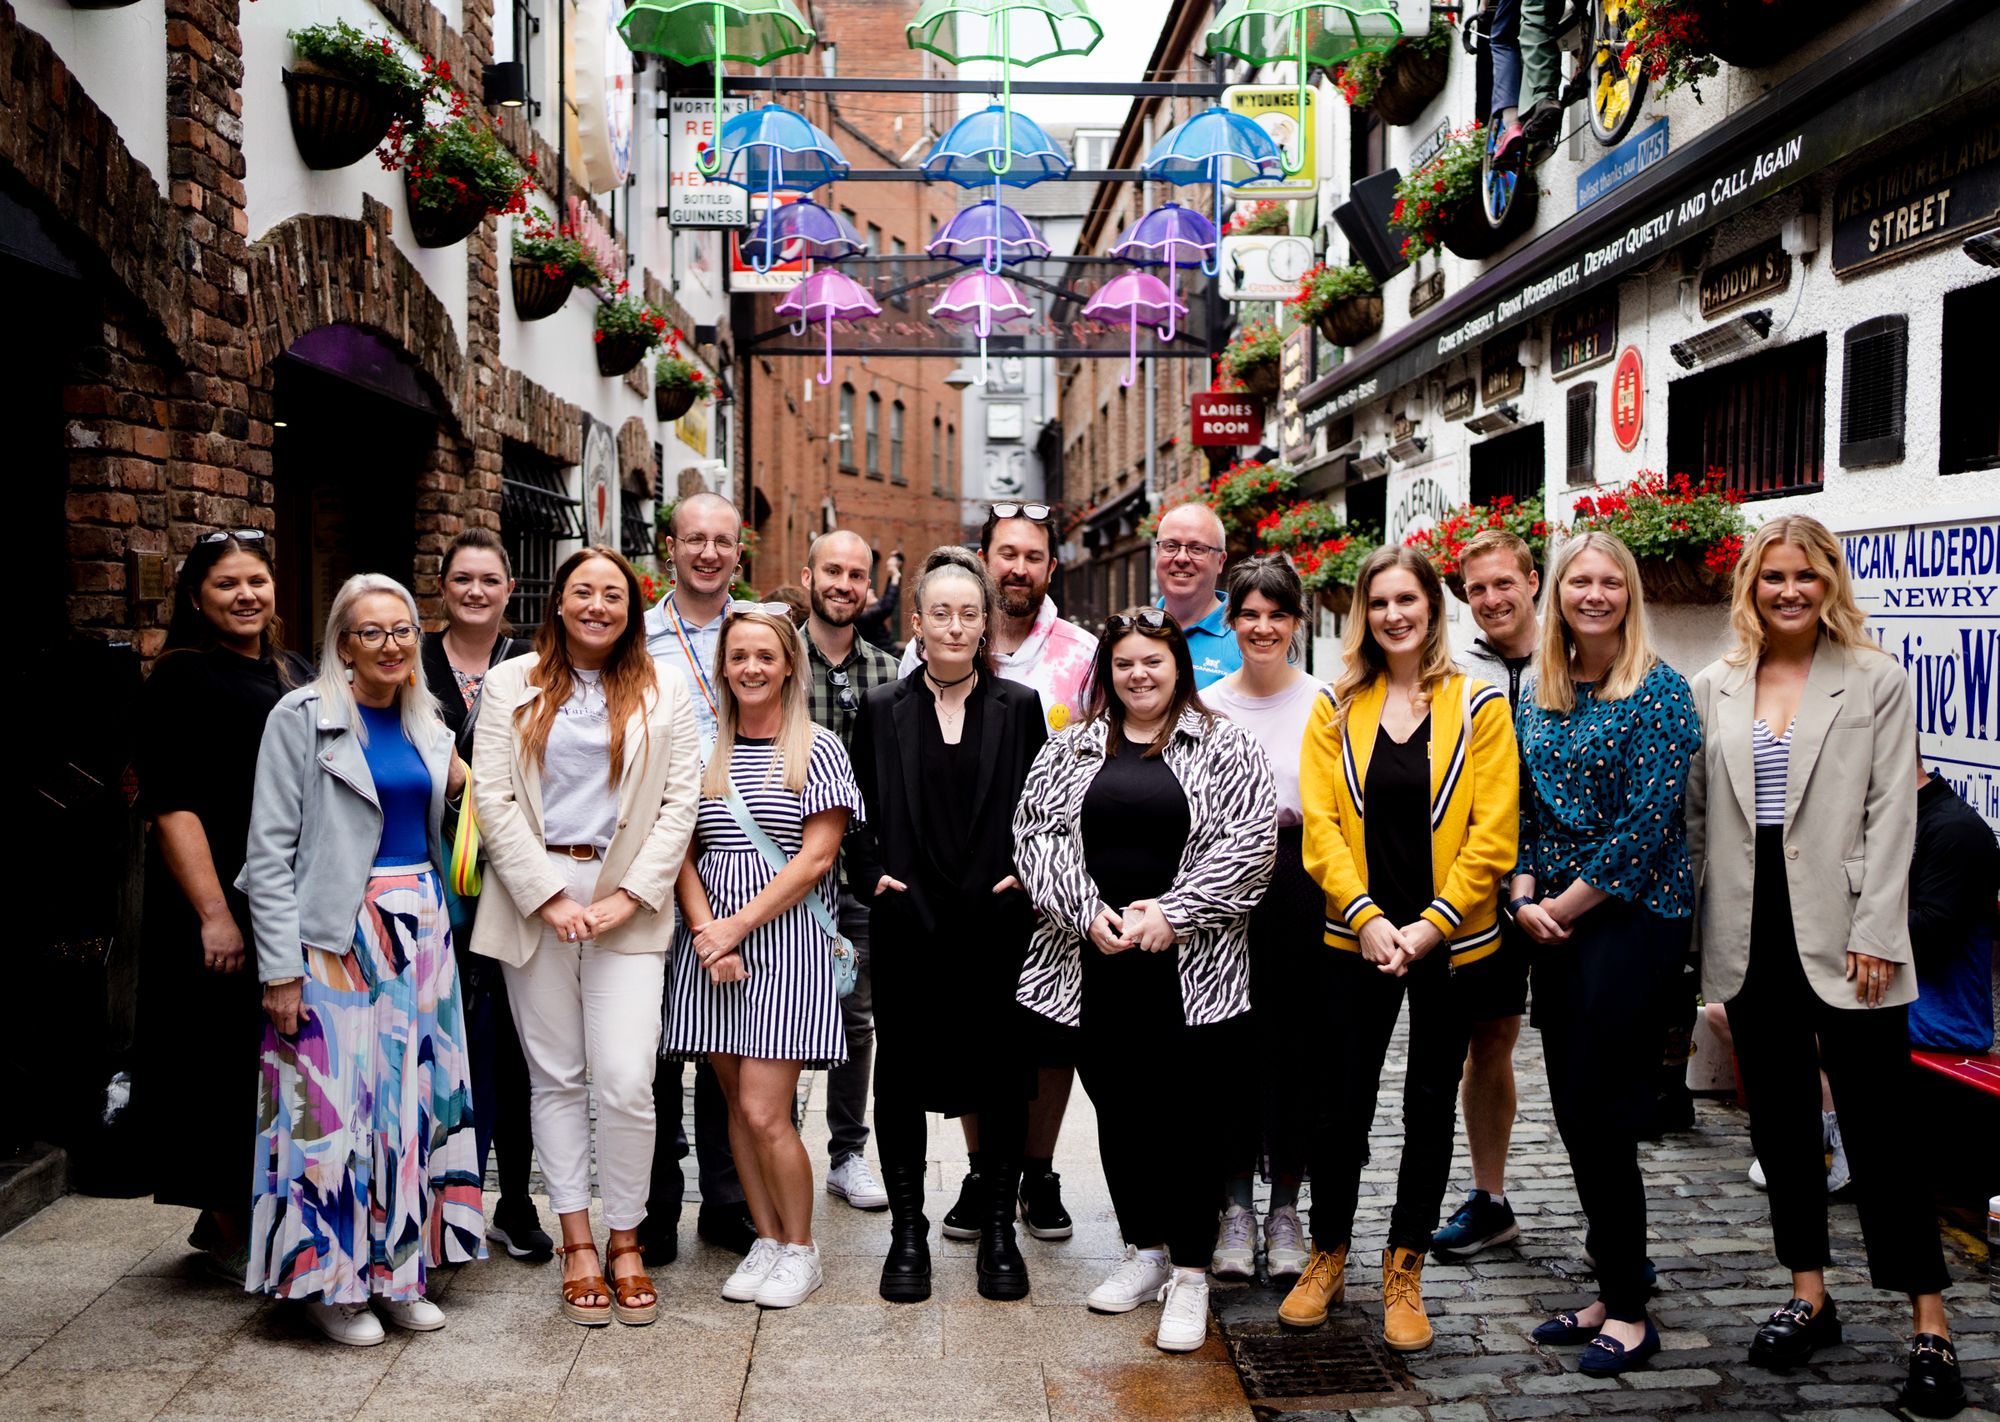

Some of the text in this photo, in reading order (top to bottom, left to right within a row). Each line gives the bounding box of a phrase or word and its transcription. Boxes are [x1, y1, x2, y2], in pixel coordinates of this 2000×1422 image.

[1579, 132, 1663, 207] Belfast thanks our NHS
[670, 172, 746, 187] HEART
[683, 194, 732, 205] BOTTLED
[1583, 239, 1625, 277] DEPART
[1625, 209, 1674, 255] QUIETLY
[1677, 192, 1705, 228] AND
[1711, 169, 1748, 207] CALL
[1749, 135, 1803, 186] AGAIN
[672, 209, 744, 223] GUINNESS
[1868, 189, 1951, 252] STREET
[1249, 284, 1301, 293] GUINNES
[1561, 334, 1600, 369] STREET
[1200, 404, 1252, 417] LADIES
[1203, 422, 1249, 434] ROOM
[1840, 524, 2000, 582] NCAN, ALDERD
[1883, 585, 1998, 608] NEWRY
